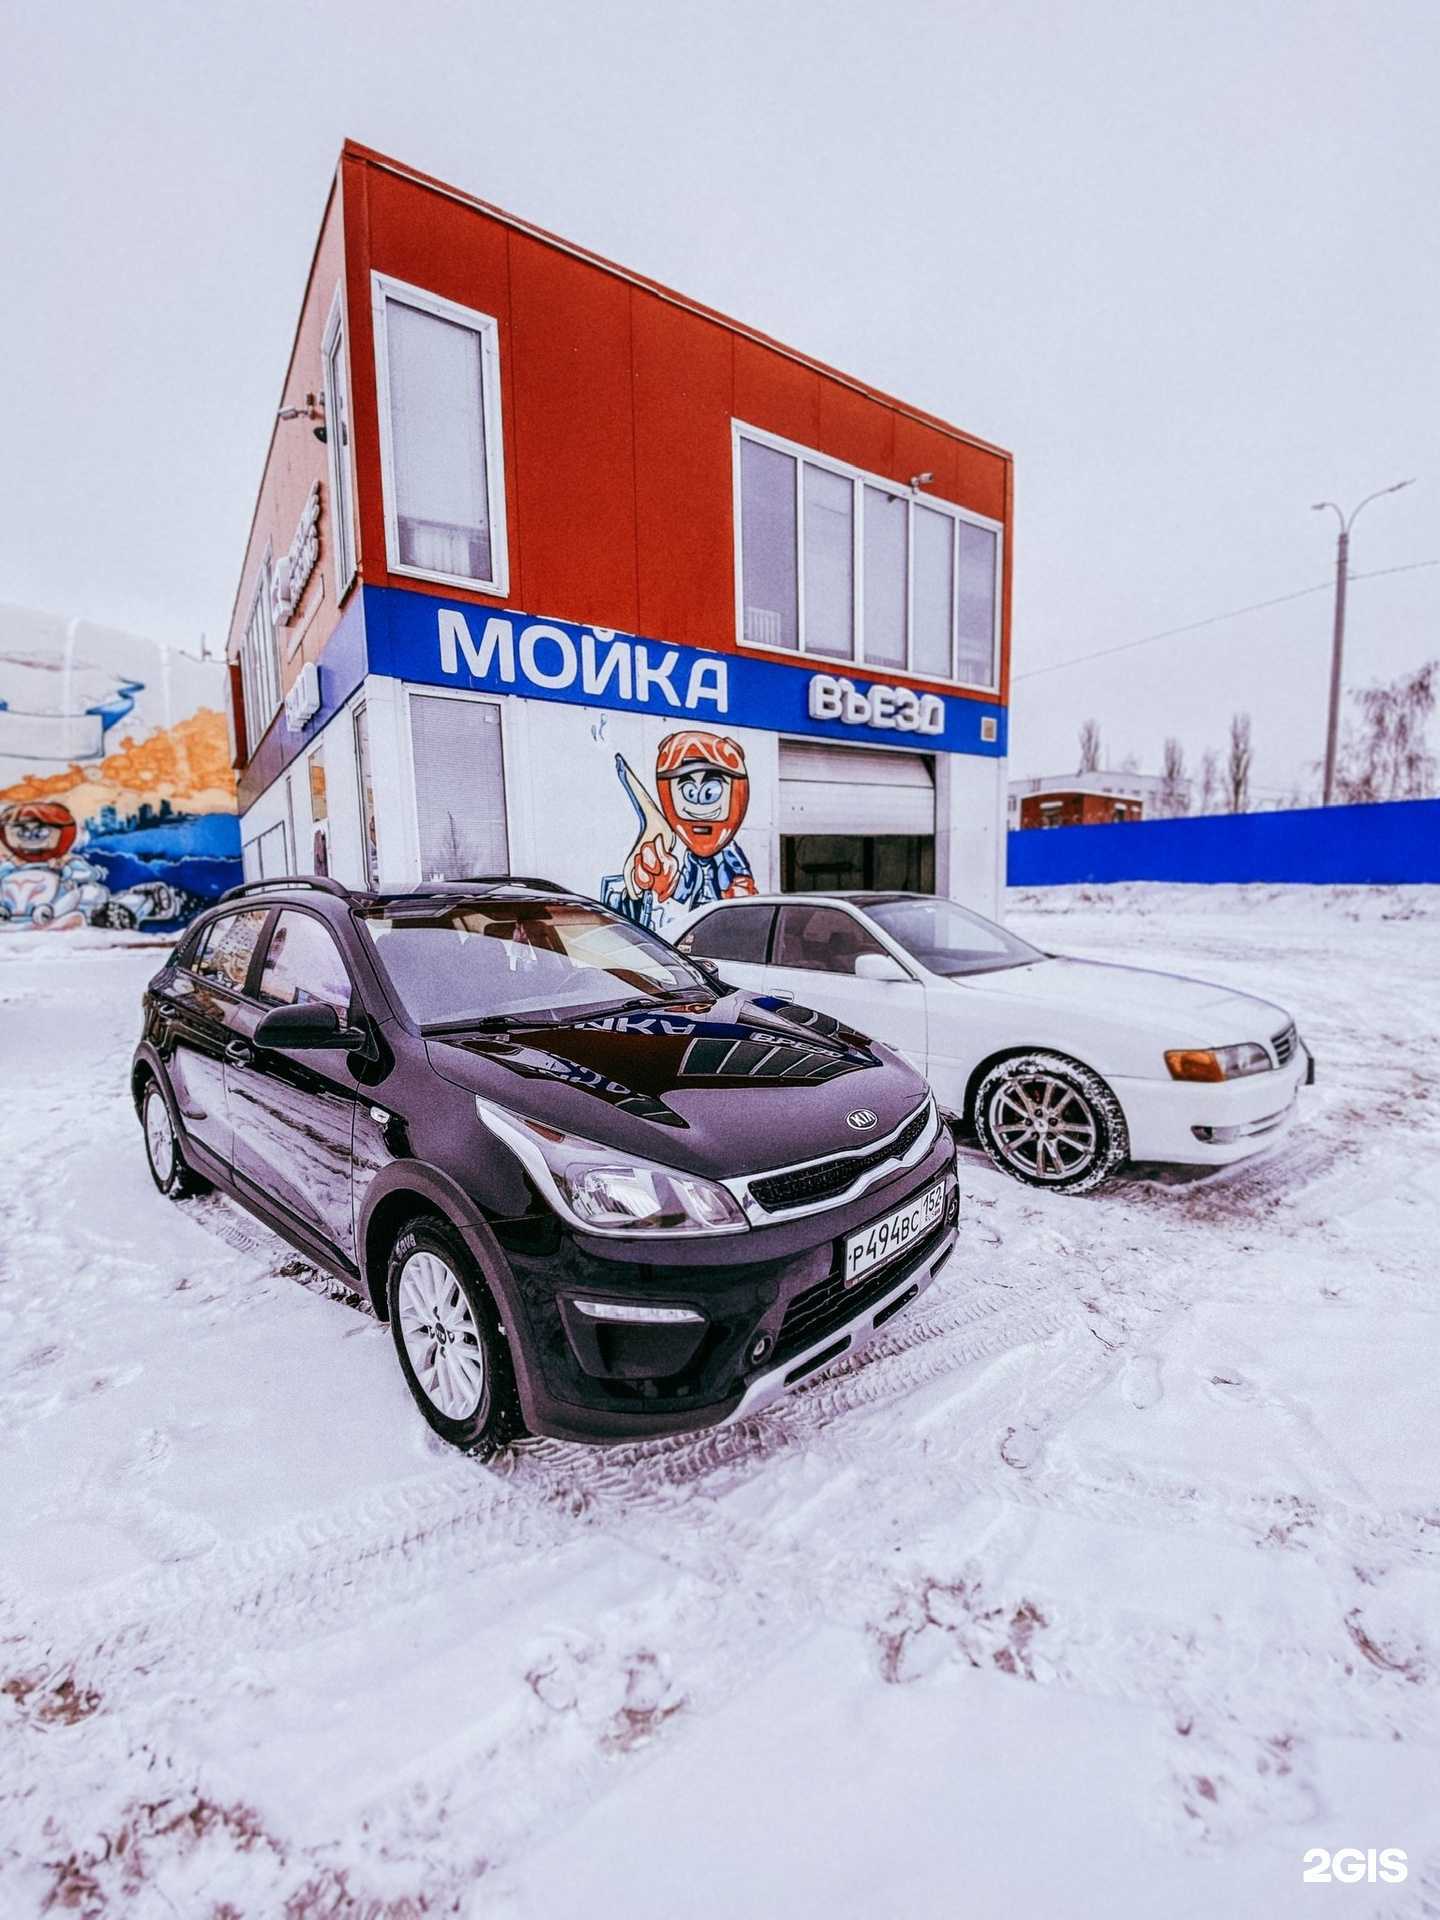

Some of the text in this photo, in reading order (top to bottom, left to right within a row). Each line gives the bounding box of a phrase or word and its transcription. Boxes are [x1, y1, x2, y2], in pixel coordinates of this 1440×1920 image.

[438, 609, 728, 713] МОЙКА
[809, 674, 945, 735] ВЪЕЗД
[850, 1111, 876, 1127] KIA
